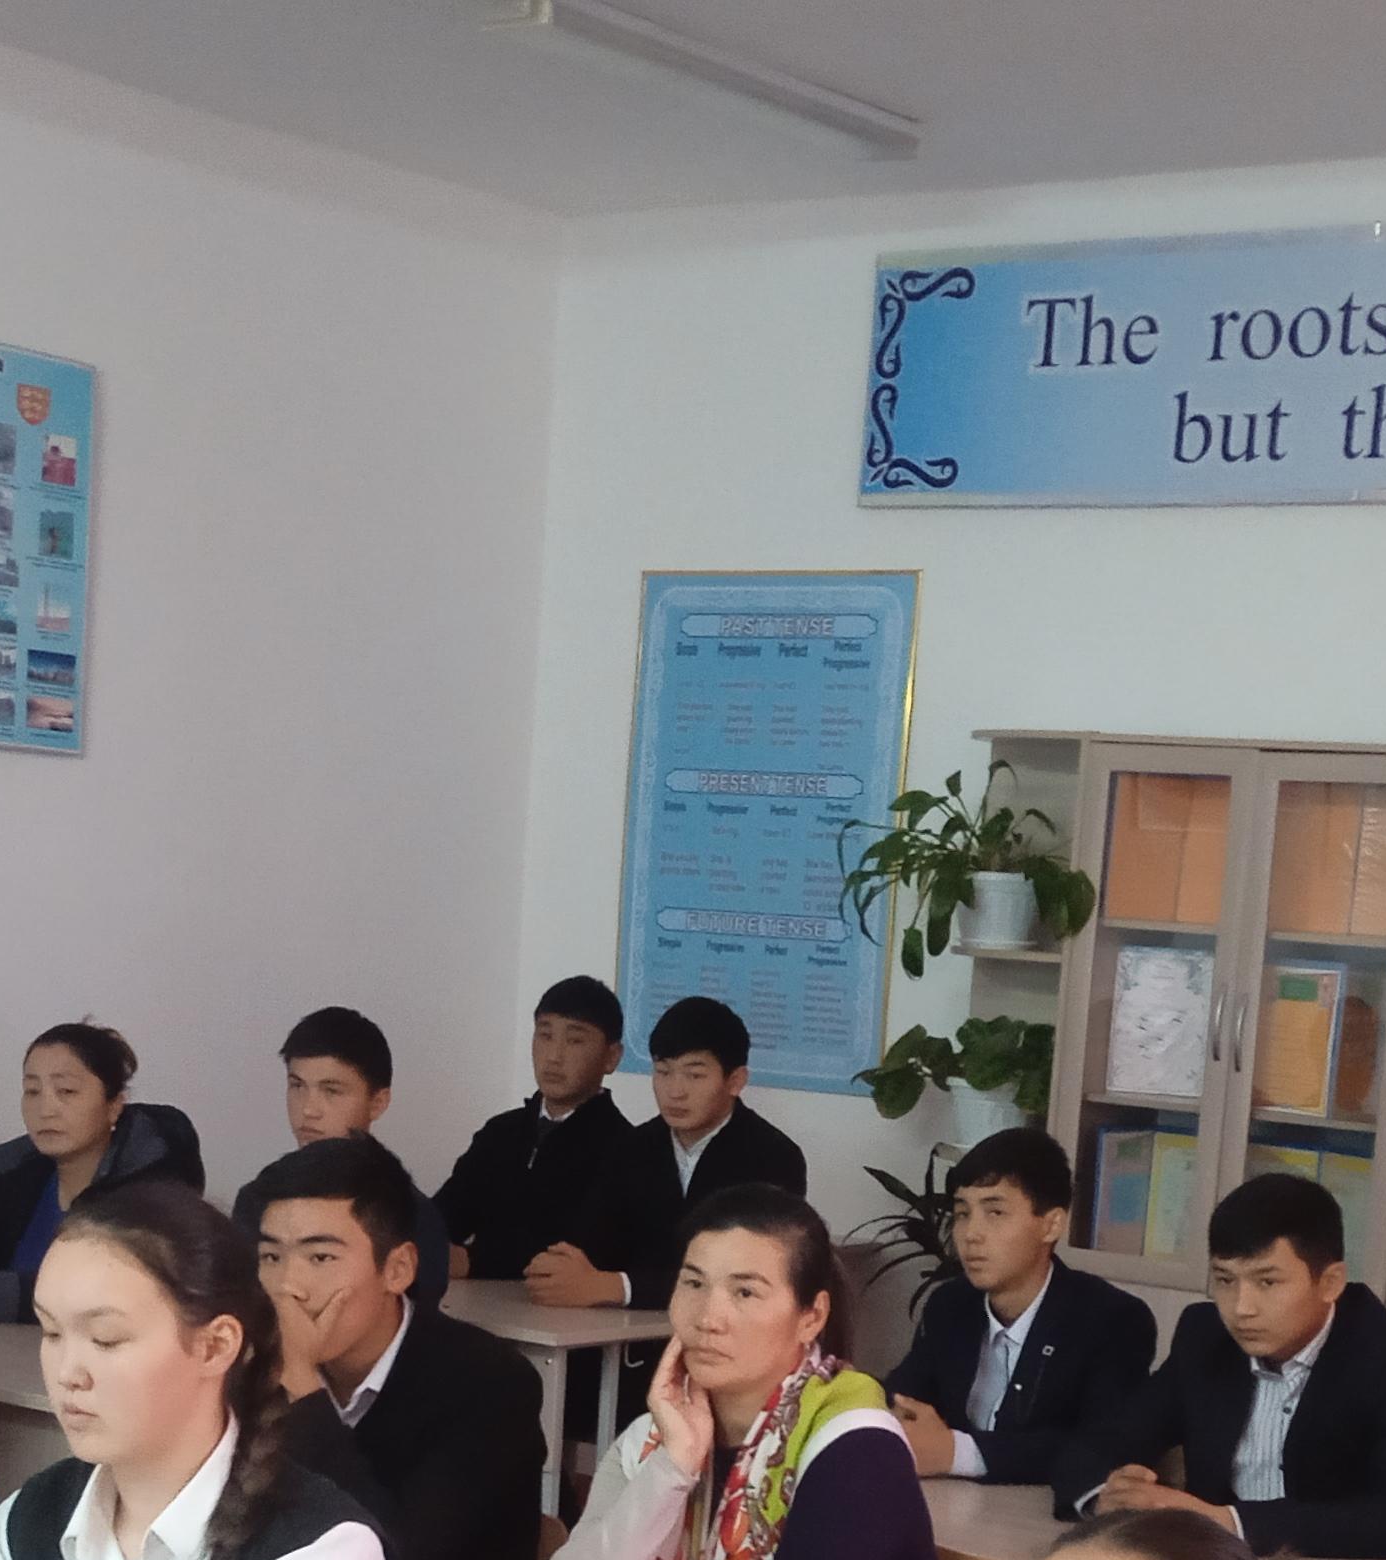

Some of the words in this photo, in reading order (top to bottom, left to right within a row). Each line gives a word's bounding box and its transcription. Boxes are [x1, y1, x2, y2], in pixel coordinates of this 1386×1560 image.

[1027, 295, 1159, 369] The
[1172, 392, 1290, 464] but
[720, 616, 770, 636] PAST
[774, 617, 835, 637] TENSE
[773, 776, 827, 795] TENSE
[685, 912, 759, 934] FUTURE
[764, 916, 827, 938] TENSE
